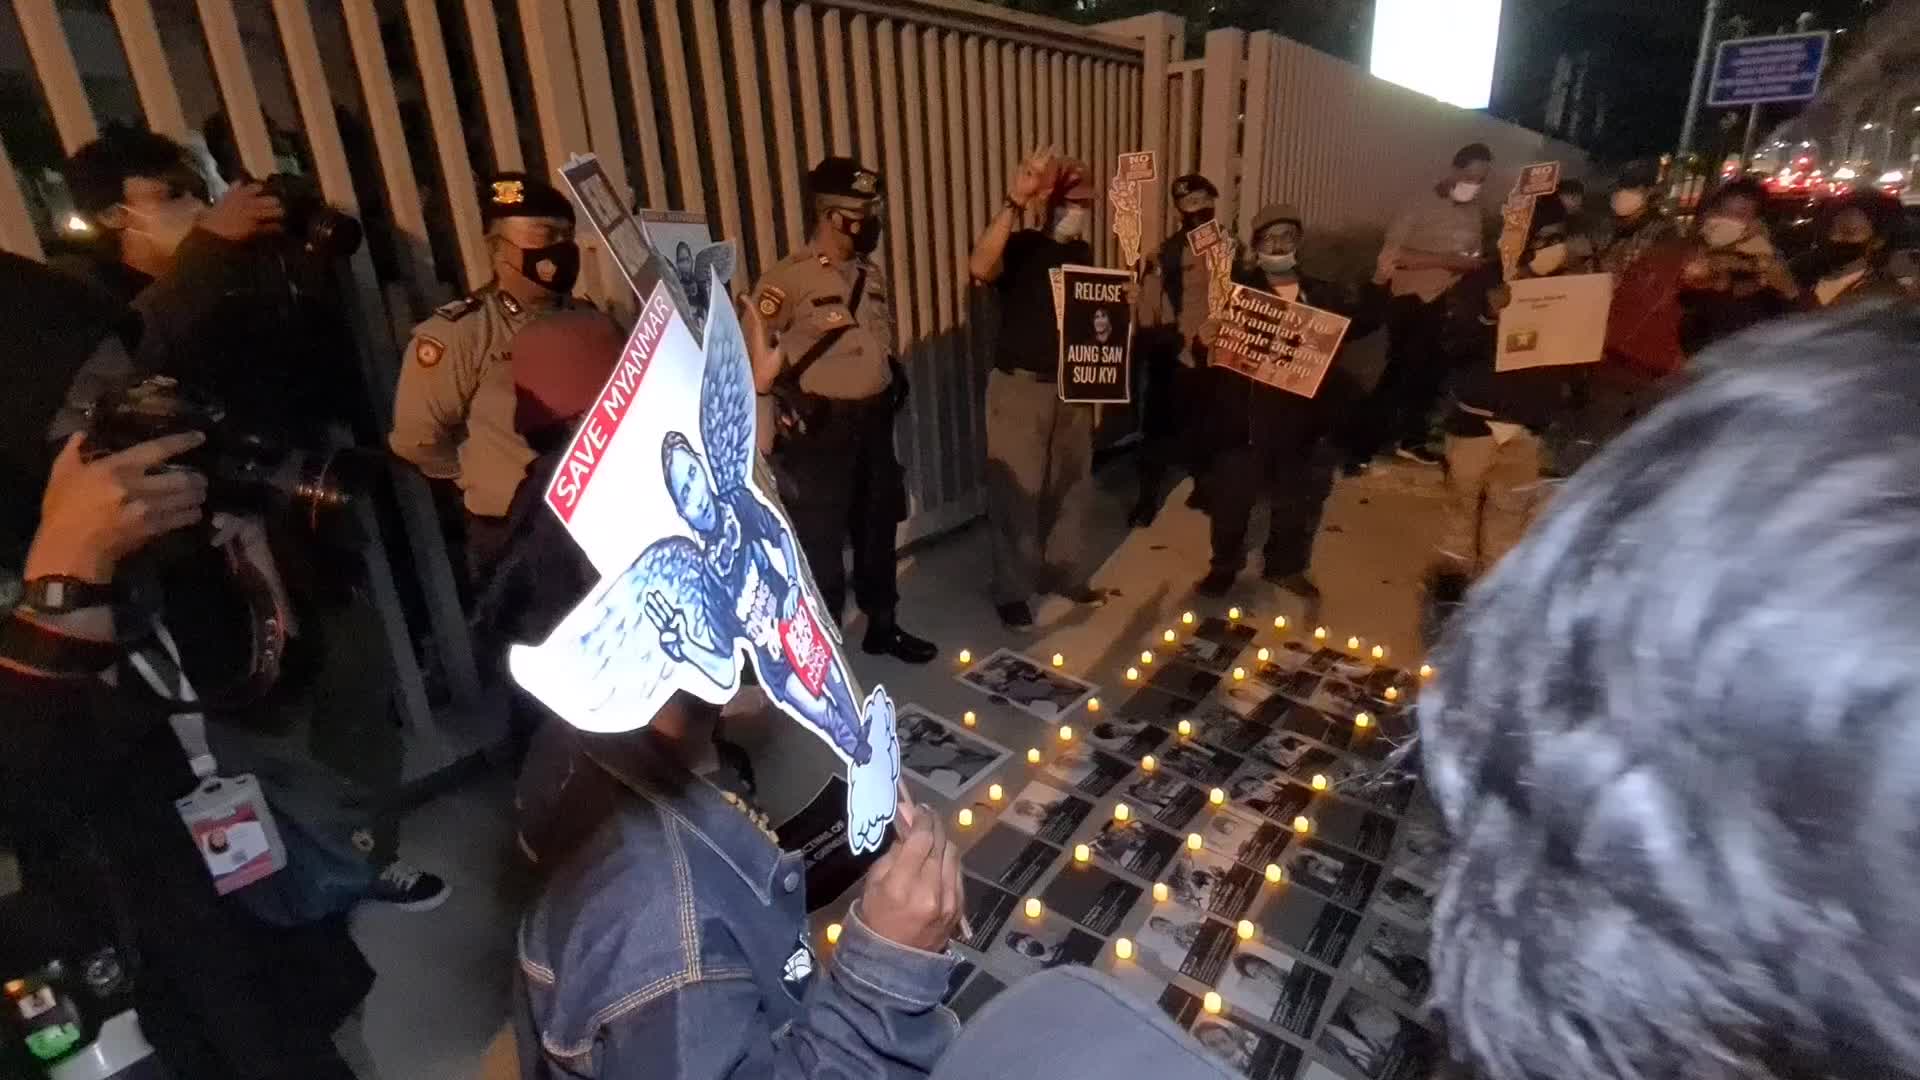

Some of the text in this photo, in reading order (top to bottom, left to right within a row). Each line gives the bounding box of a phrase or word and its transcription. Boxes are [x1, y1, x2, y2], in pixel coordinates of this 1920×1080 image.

[1128, 154, 1150, 164] NO
[1074, 281, 1122, 302] RELEASE
[1229, 293, 1303, 328] Solidarity
[1218, 325, 1269, 347] people
[1067, 344, 1124, 363] AUNG SAN
[1214, 337, 1312, 378] military coup
[1072, 366, 1117, 384] SUU KYI
[556, 295, 670, 507] SAVE MYANMAR
